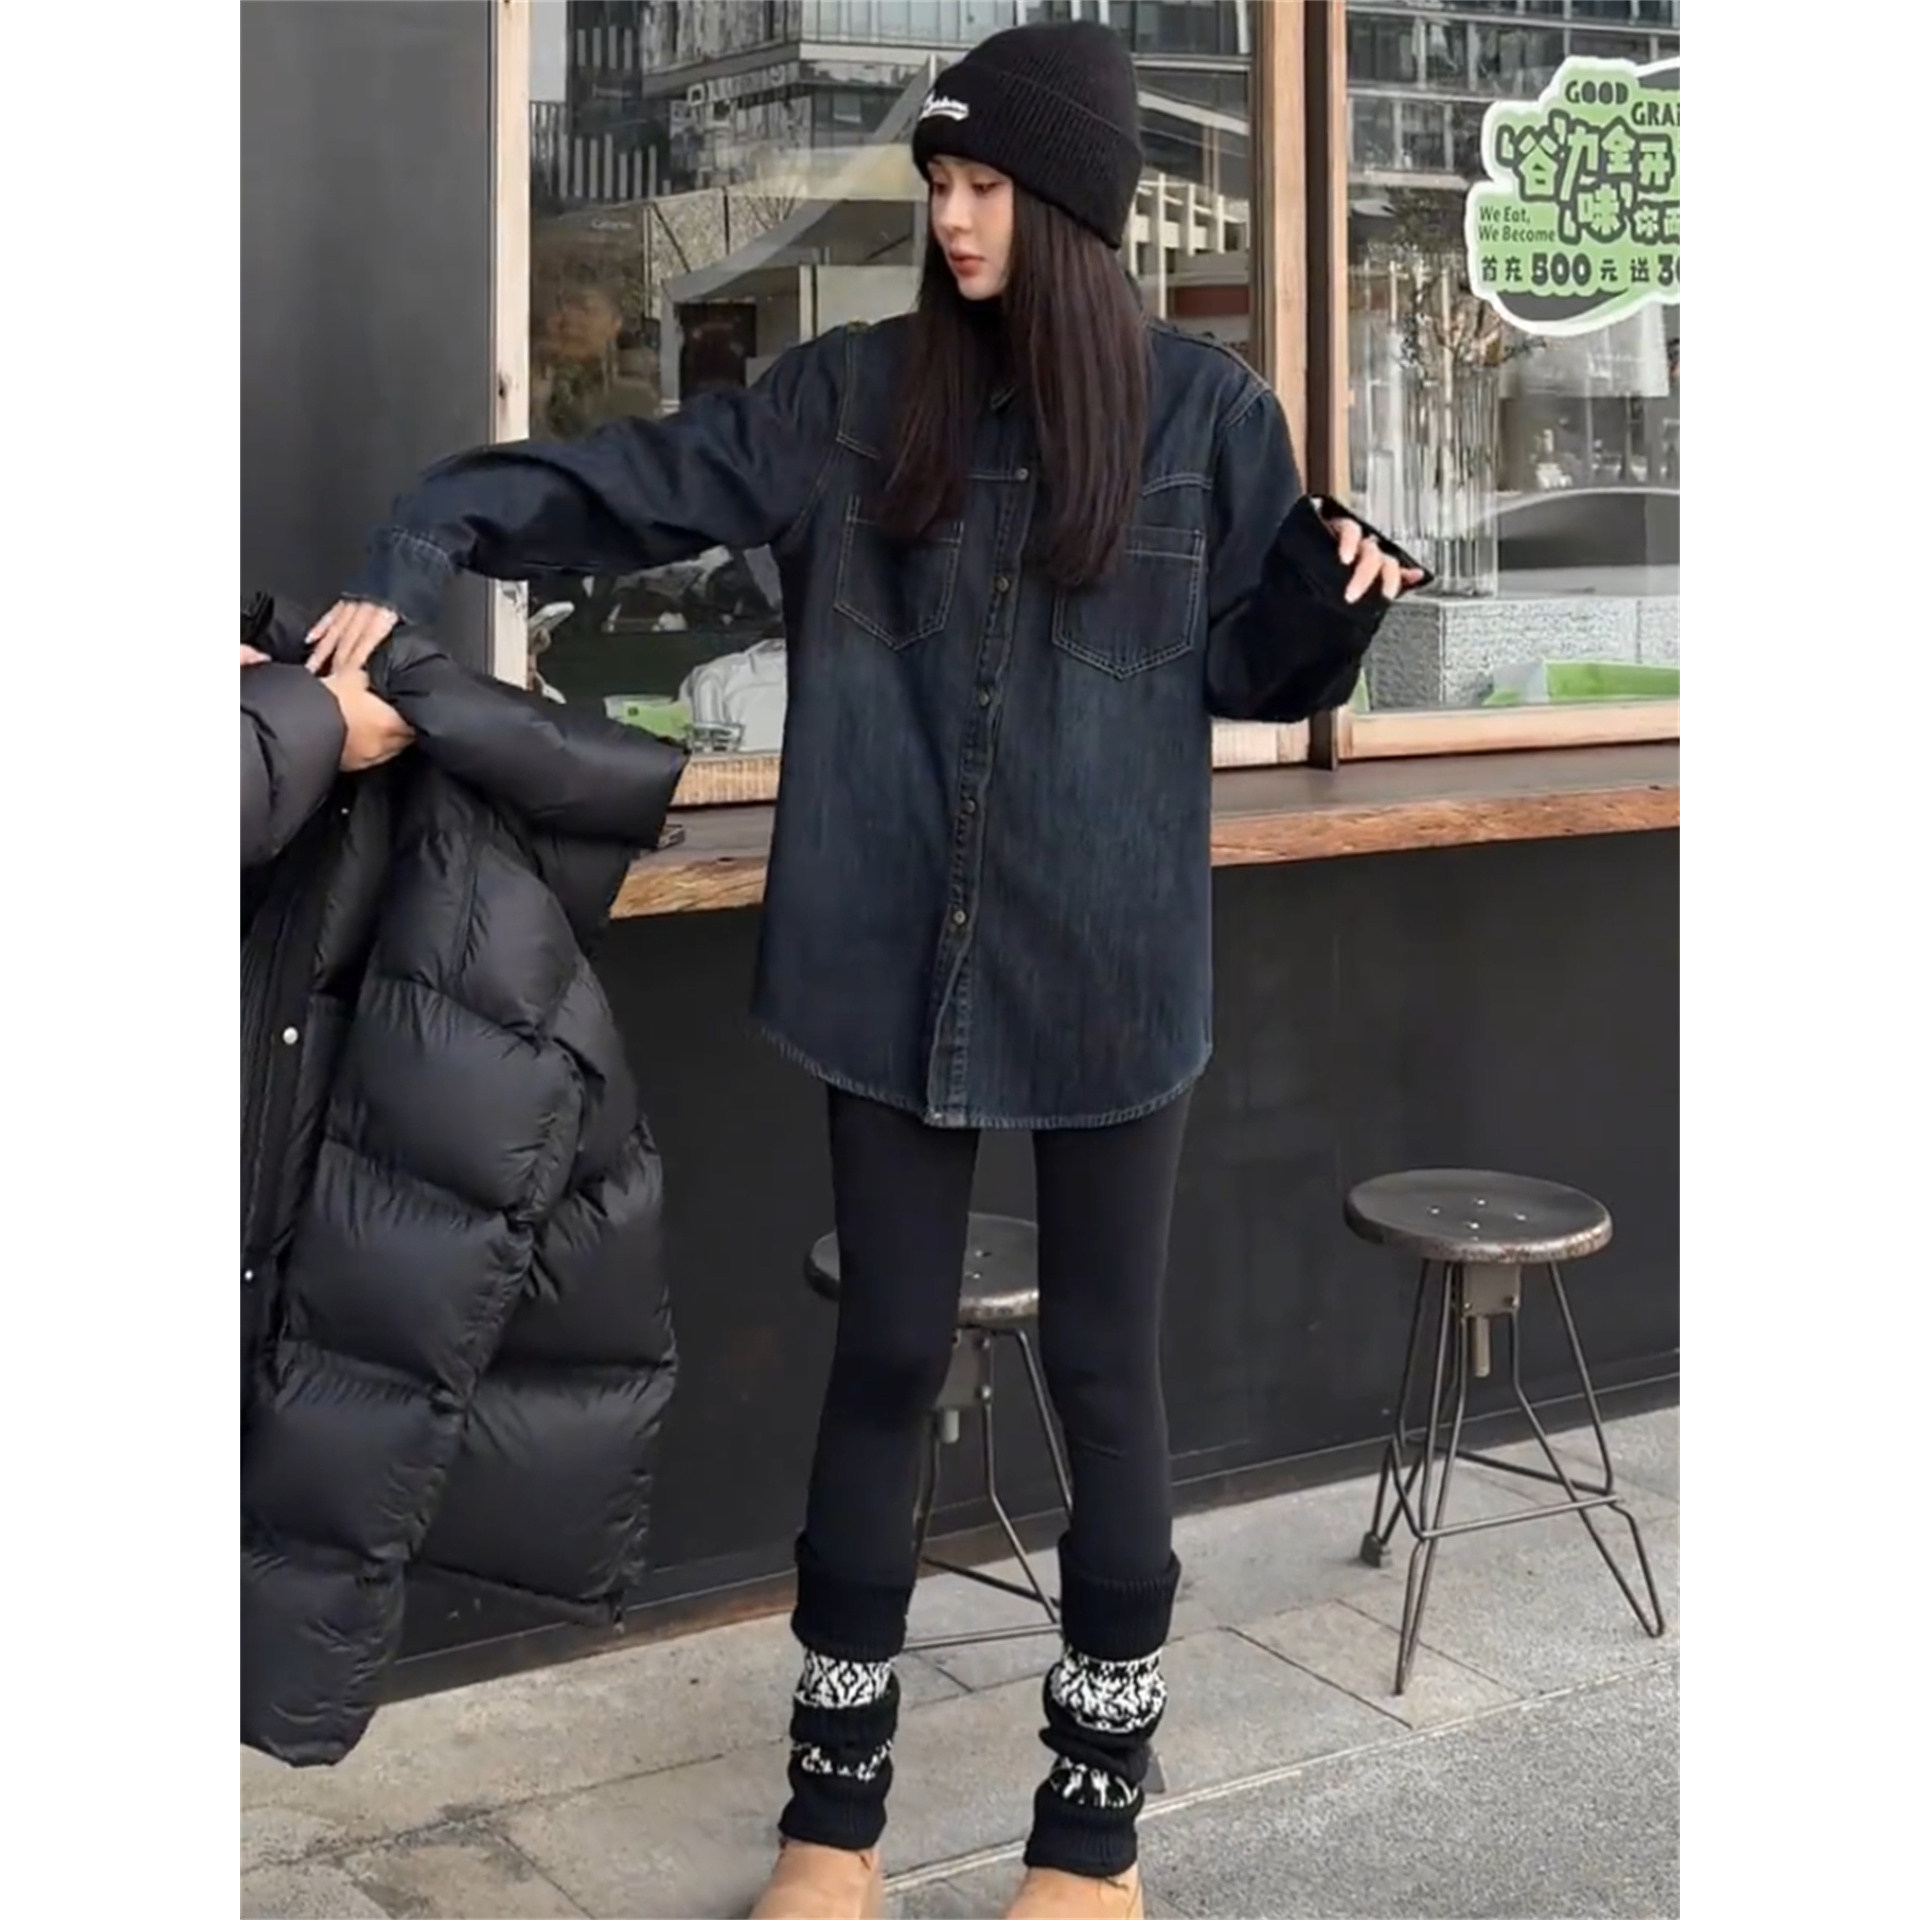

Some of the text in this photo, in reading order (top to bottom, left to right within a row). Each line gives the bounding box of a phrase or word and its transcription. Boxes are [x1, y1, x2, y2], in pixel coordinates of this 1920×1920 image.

[1565, 80, 1629, 105] GOOD
[1479, 206, 1531, 224] We Eat,
[1478, 225, 1556, 242] We Become
[1481, 253, 1680, 286] 首充500元送3
